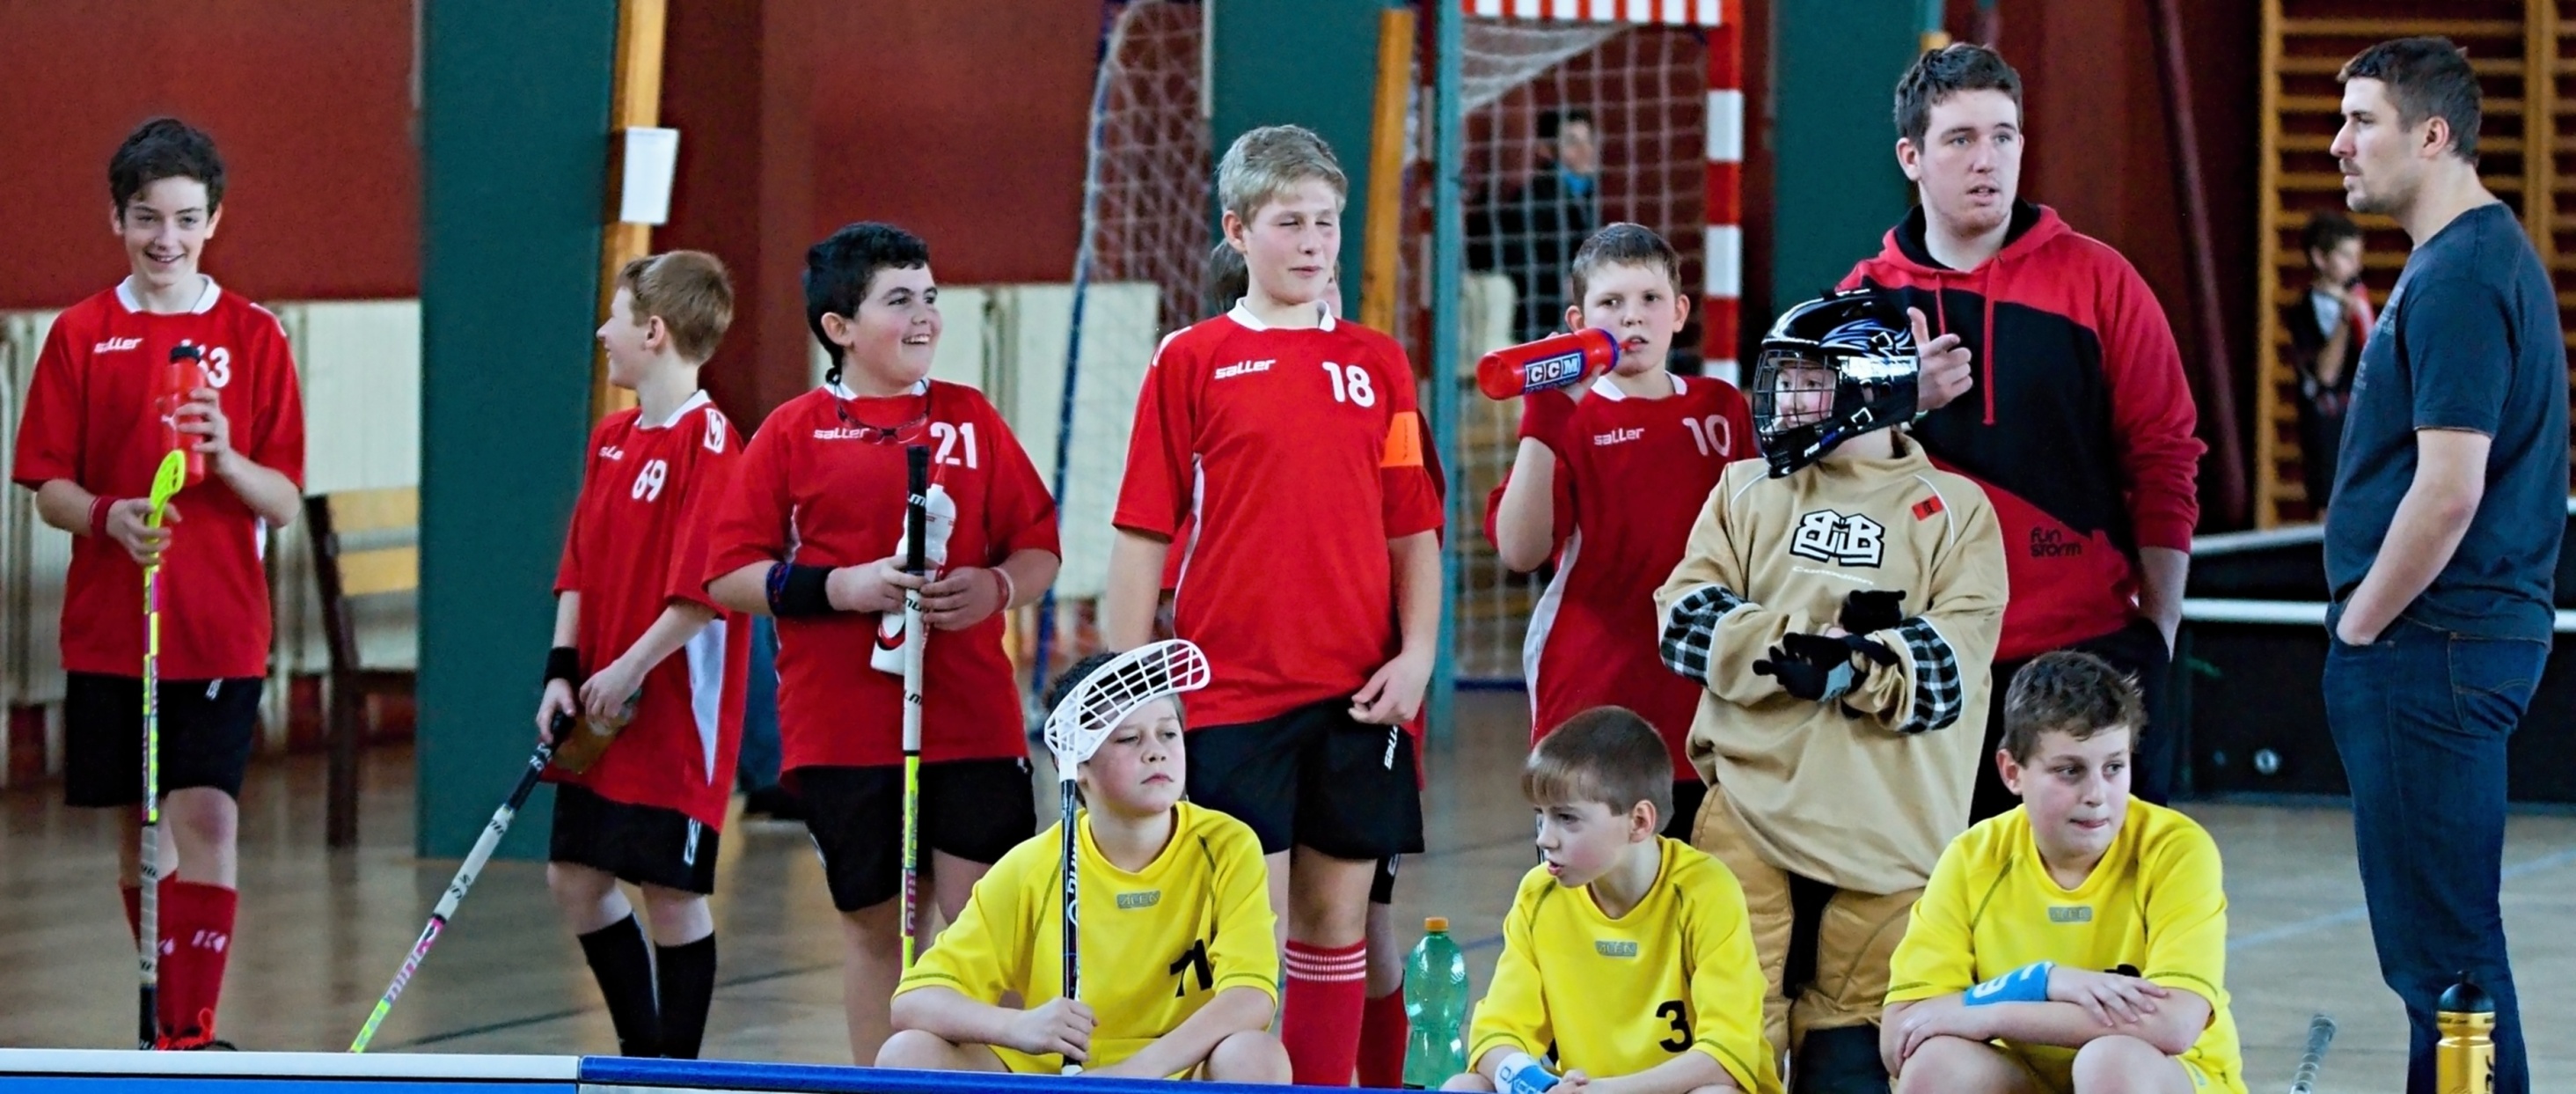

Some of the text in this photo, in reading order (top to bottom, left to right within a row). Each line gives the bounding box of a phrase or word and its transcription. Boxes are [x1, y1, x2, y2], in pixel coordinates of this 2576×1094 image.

[1214, 359, 1277, 379] saller
[1321, 361, 1375, 408] 18
[1531, 357, 1578, 382] CCM
[813, 427, 870, 440] saller
[930, 422, 977, 470] 21
[1593, 427, 1645, 446] saller
[1682, 415, 1731, 458] 10
[631, 459, 668, 503] 69
[1655, 1000, 1694, 1054] 3
